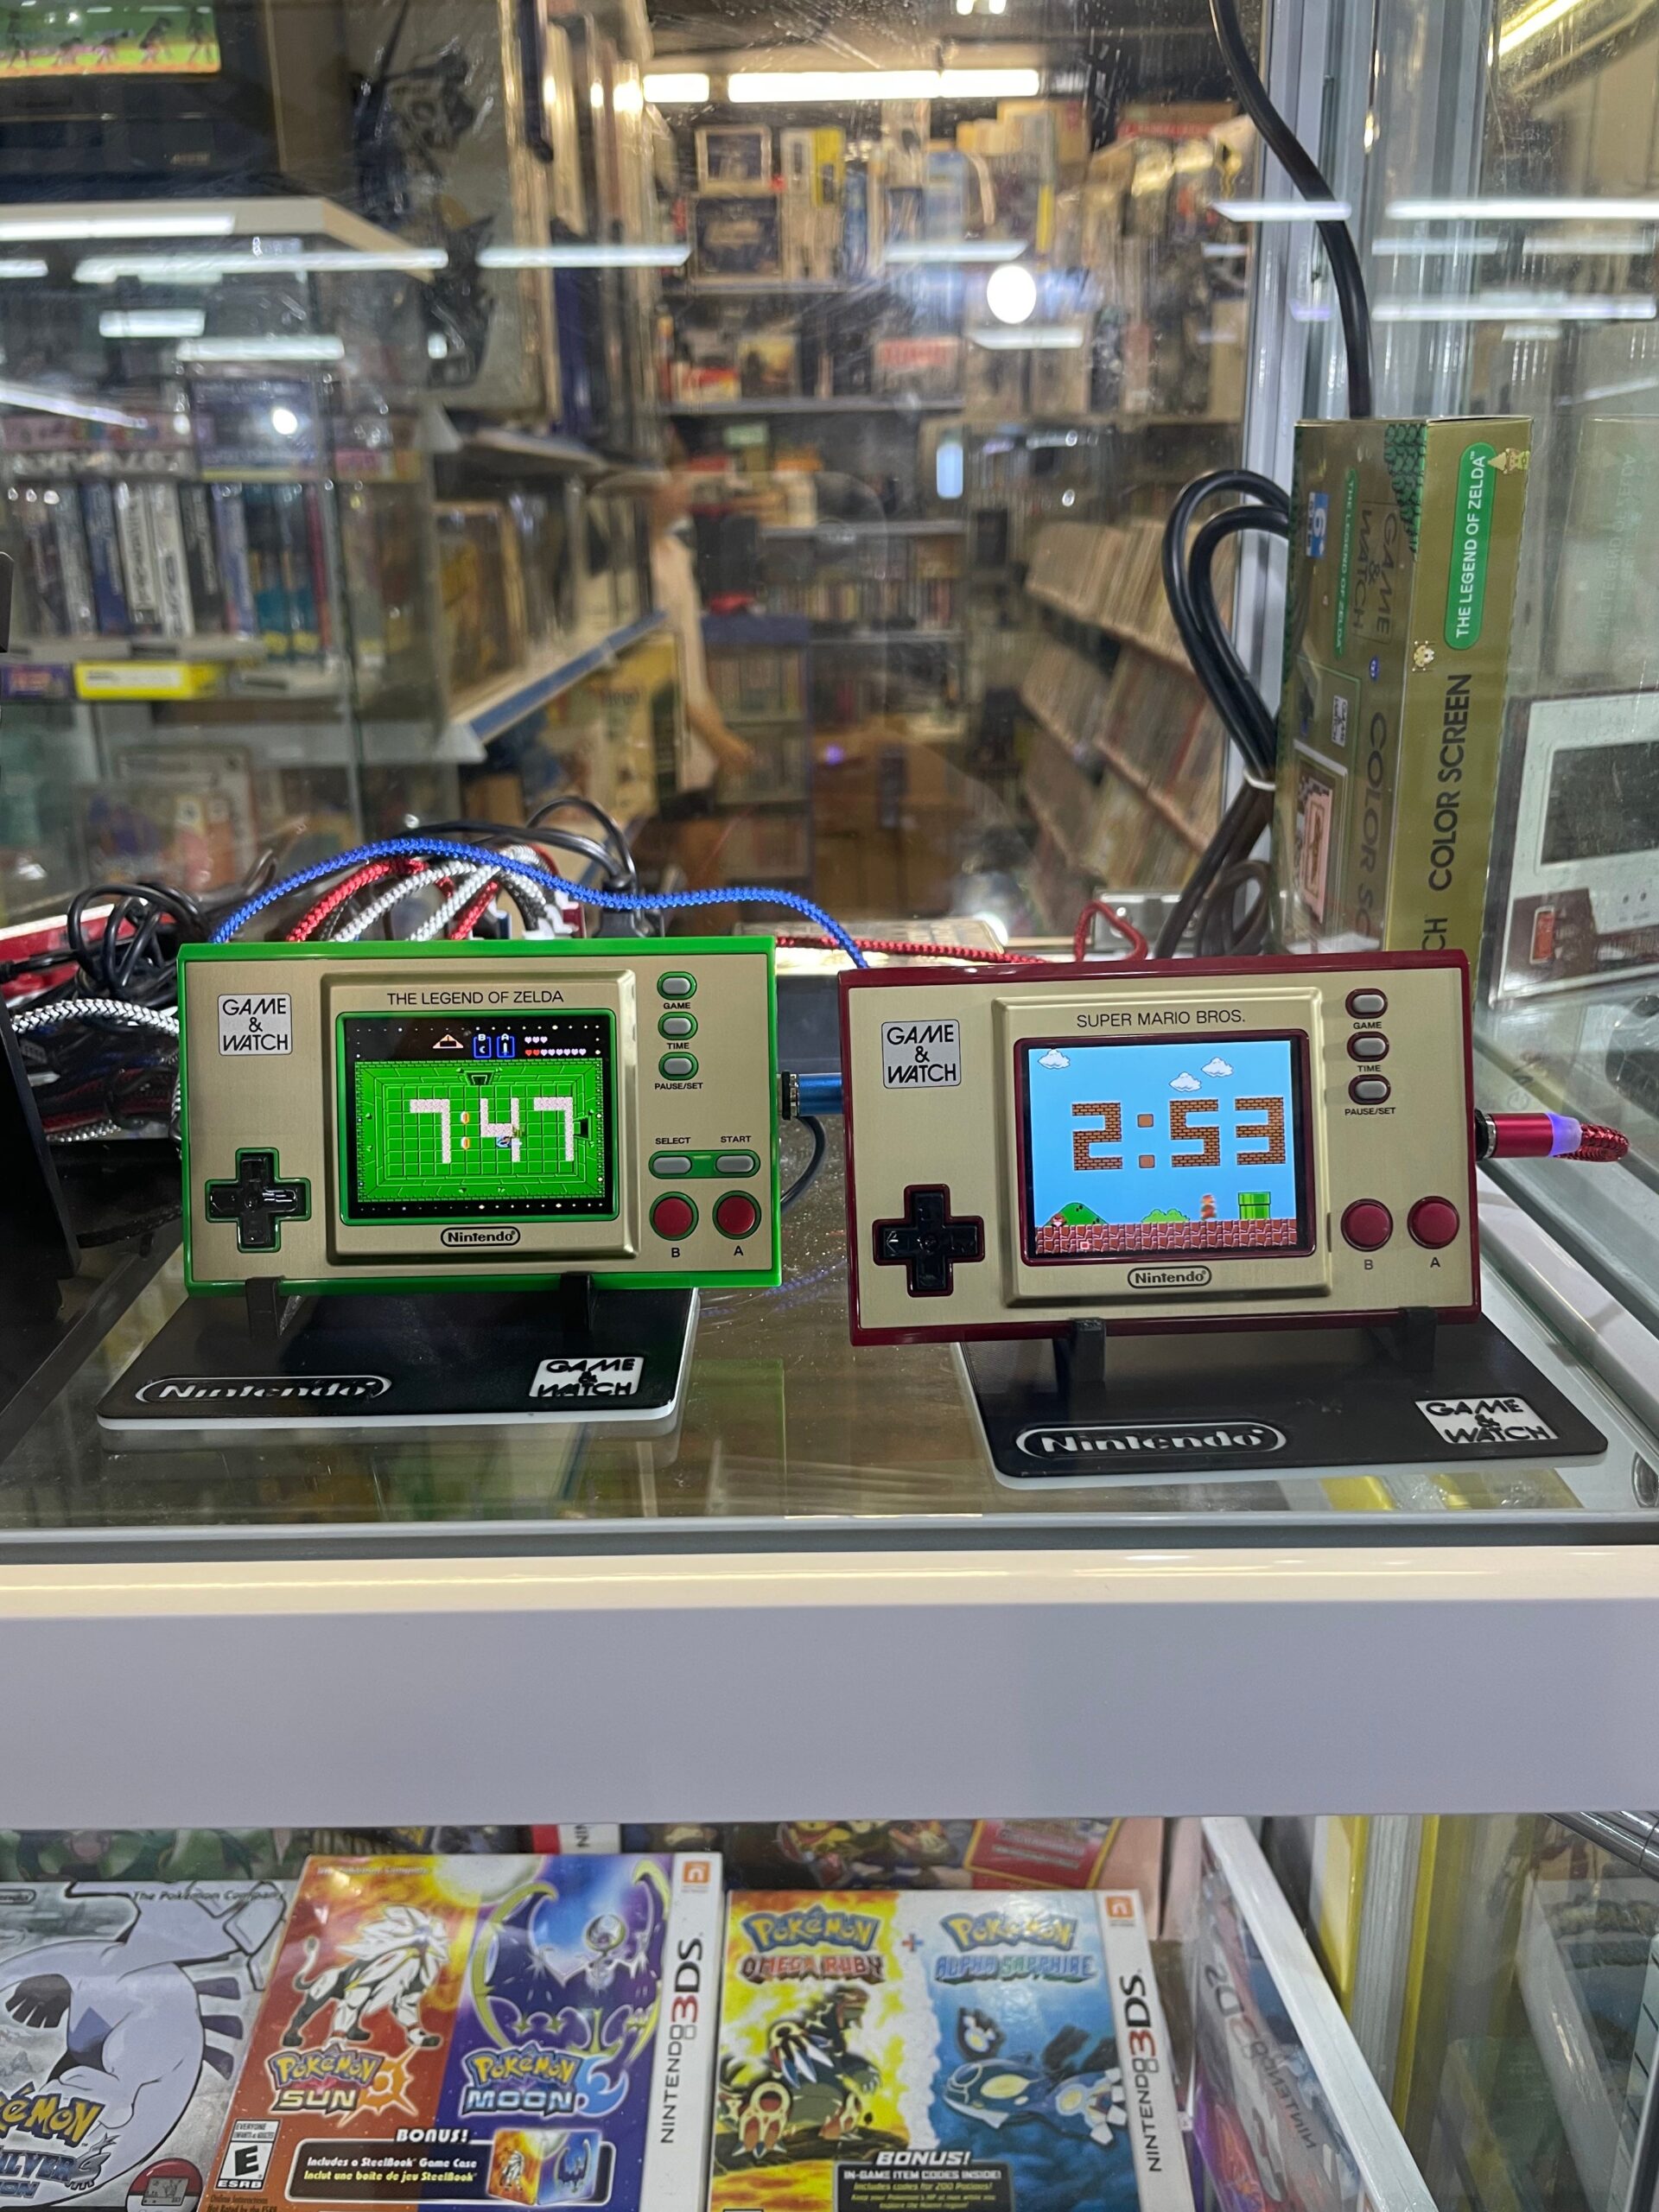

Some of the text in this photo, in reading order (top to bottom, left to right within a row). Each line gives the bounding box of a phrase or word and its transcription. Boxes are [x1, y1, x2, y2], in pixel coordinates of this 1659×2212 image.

[1466, 513, 1480, 535] OF
[1352, 509, 1372, 630] WATCH
[1376, 512, 1398, 635] GAME
[1459, 538, 1478, 605] LEGEND
[1455, 606, 1471, 639] THE
[1427, 674, 1472, 892] COLOR SCREEN
[1359, 712, 1386, 874] COLOR
[222, 997, 287, 1015] GAME
[387, 990, 564, 1005] THE LEGEND OF ZELDA
[248, 1017, 264, 1033] &
[1077, 1009, 1246, 1028] SUPER MARIO BROS.
[223, 1034, 289, 1052] WATCH
[887, 1024, 955, 1046] GAME
[914, 1046, 931, 1064] &
[887, 1064, 957, 1084] WATCH
[654, 1082, 704, 1090] PAUSE/SET
[1344, 1107, 1396, 1116] PAUSE/SET
[410, 1096, 575, 1164] 7:47
[1071, 1096, 1287, 1172] 2:53
[447, 1230, 516, 1243] Nintendo
[671, 1247, 681, 1258] B
[733, 1245, 744, 1256] A
[1363, 1259, 1374, 1270] B
[1430, 1257, 1441, 1268] A
[1135, 1270, 1205, 1285] Nintendo
[546, 1358, 635, 1374] GAME
[158, 1382, 370, 1398] Nintendo
[537, 1382, 632, 1397] WATCH
[1426, 1399, 1524, 1416] GAME
[1474, 1414, 1500, 1427] &
[1040, 1430, 1263, 1452] Nintendo
[1444, 1426, 1551, 1443] WATCH
[740, 1955, 887, 1985] OMEGA RUBY
[935, 1954, 1098, 1983] ALPHA SAPPHIRE
[661, 1938, 703, 2145] NINTENDO 3DS
[1120, 1974, 1162, 2173] NINTENDO 3DS
[275, 2088, 358, 2110] SUN
[464, 2089, 575, 2112] MOON
[396, 2128, 469, 2143] BONUS!
[235, 2145, 259, 2177] E
[307, 2157, 349, 2167] Includes
[419, 2158, 451, 2168] Game
[453, 2158, 478, 2169] Case
[876, 2151, 971, 2165] BONUS!
[304, 2171, 331, 2181] Inclut
[385, 2171, 399, 2182] de
[400, 2171, 419, 2183] jeu
[843, 2170, 891, 2180] IN-GAME
[893, 2171, 920, 2180] ITEM
[921, 2171, 960, 2180] CODES
[218, 2180, 263, 2189] ESRB
